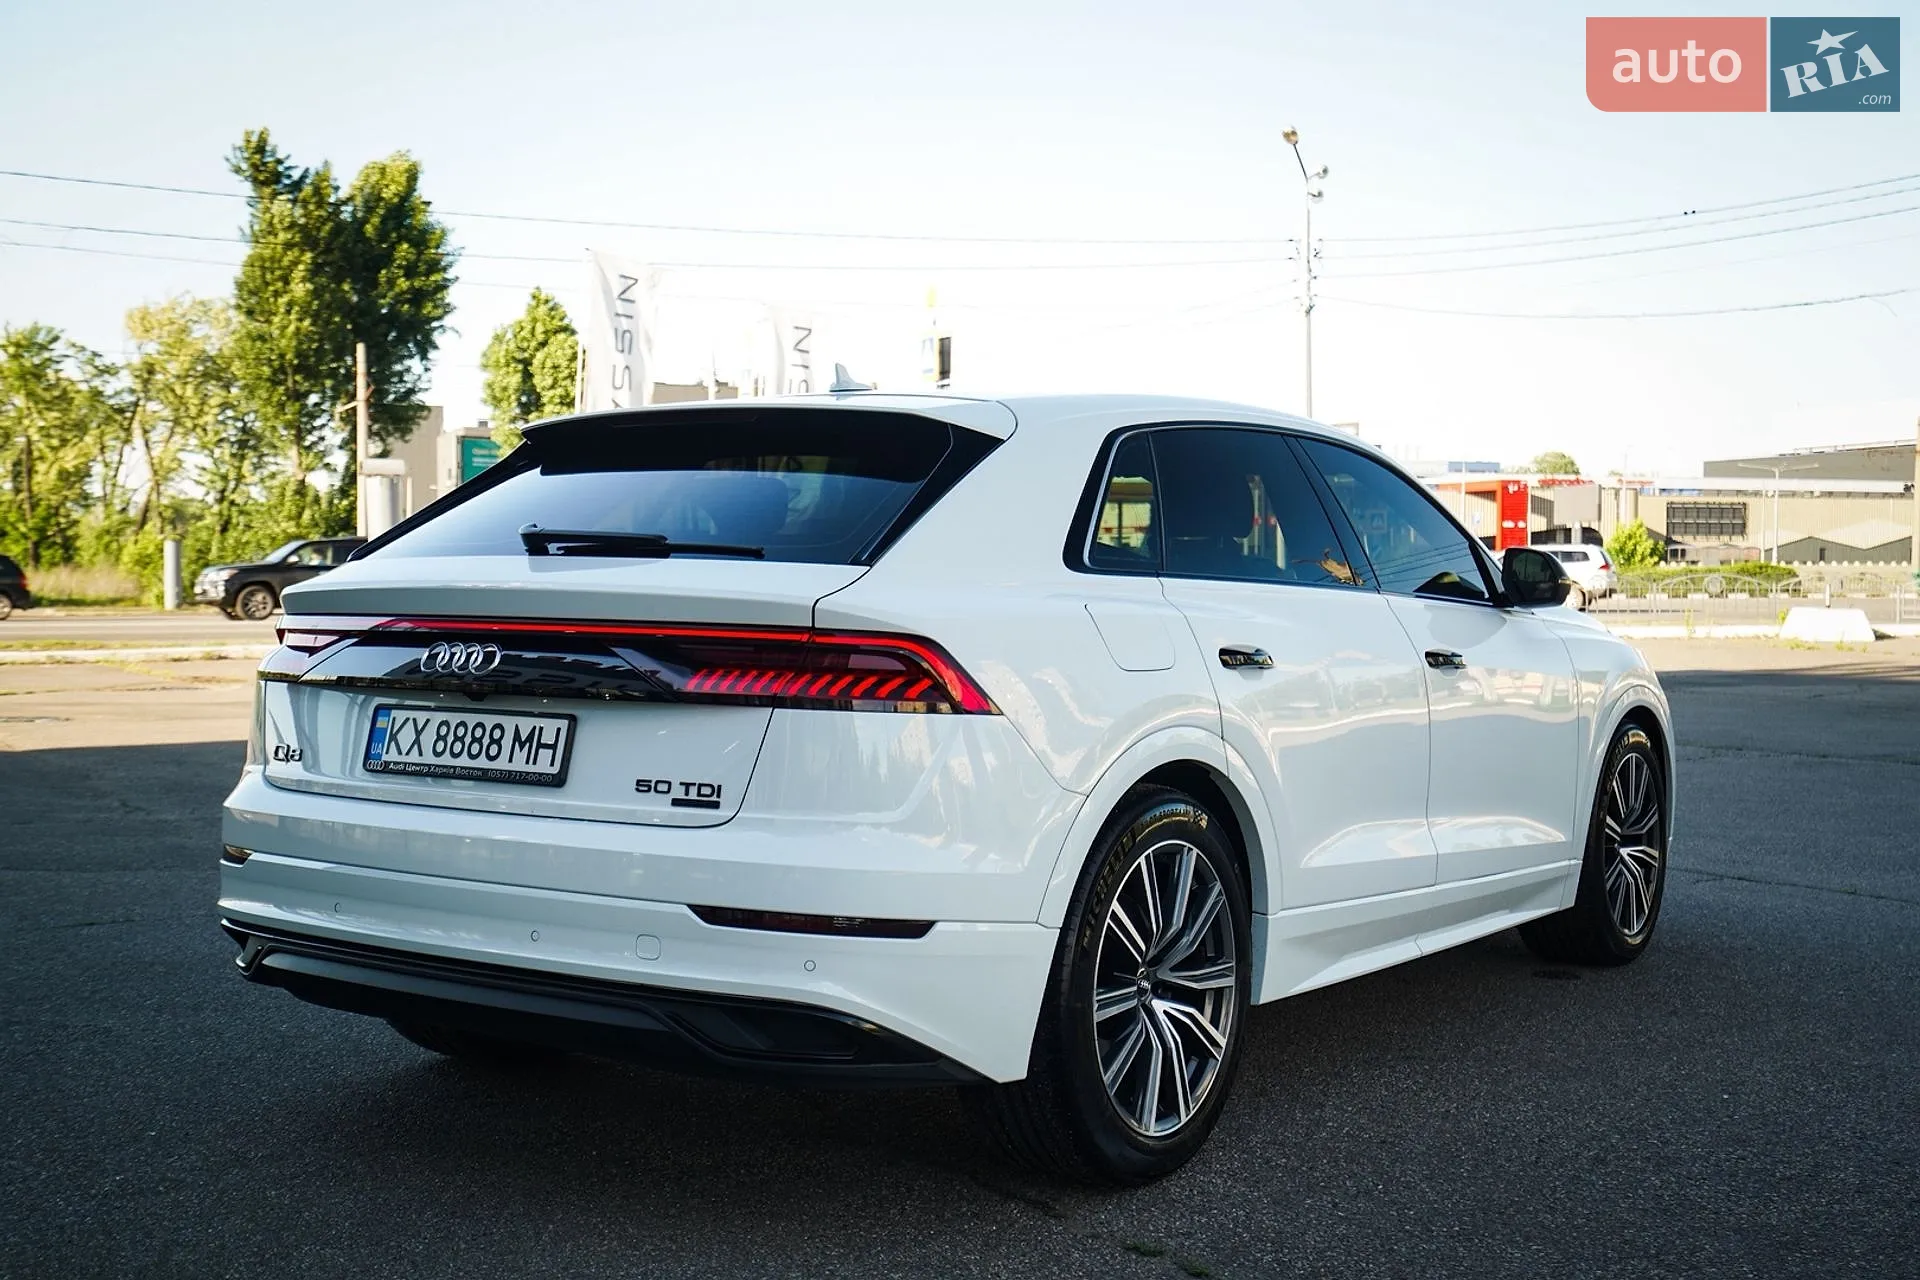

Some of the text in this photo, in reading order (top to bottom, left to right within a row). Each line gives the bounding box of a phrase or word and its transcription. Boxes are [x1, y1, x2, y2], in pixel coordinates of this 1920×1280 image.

[371, 742, 383, 755] UA
[385, 716, 562, 767] KX 8888 MH
[273, 744, 304, 765] Q8
[389, 761, 404, 771] Audi
[405, 763, 429, 773] Центр
[635, 779, 722, 799] 50 TDI
